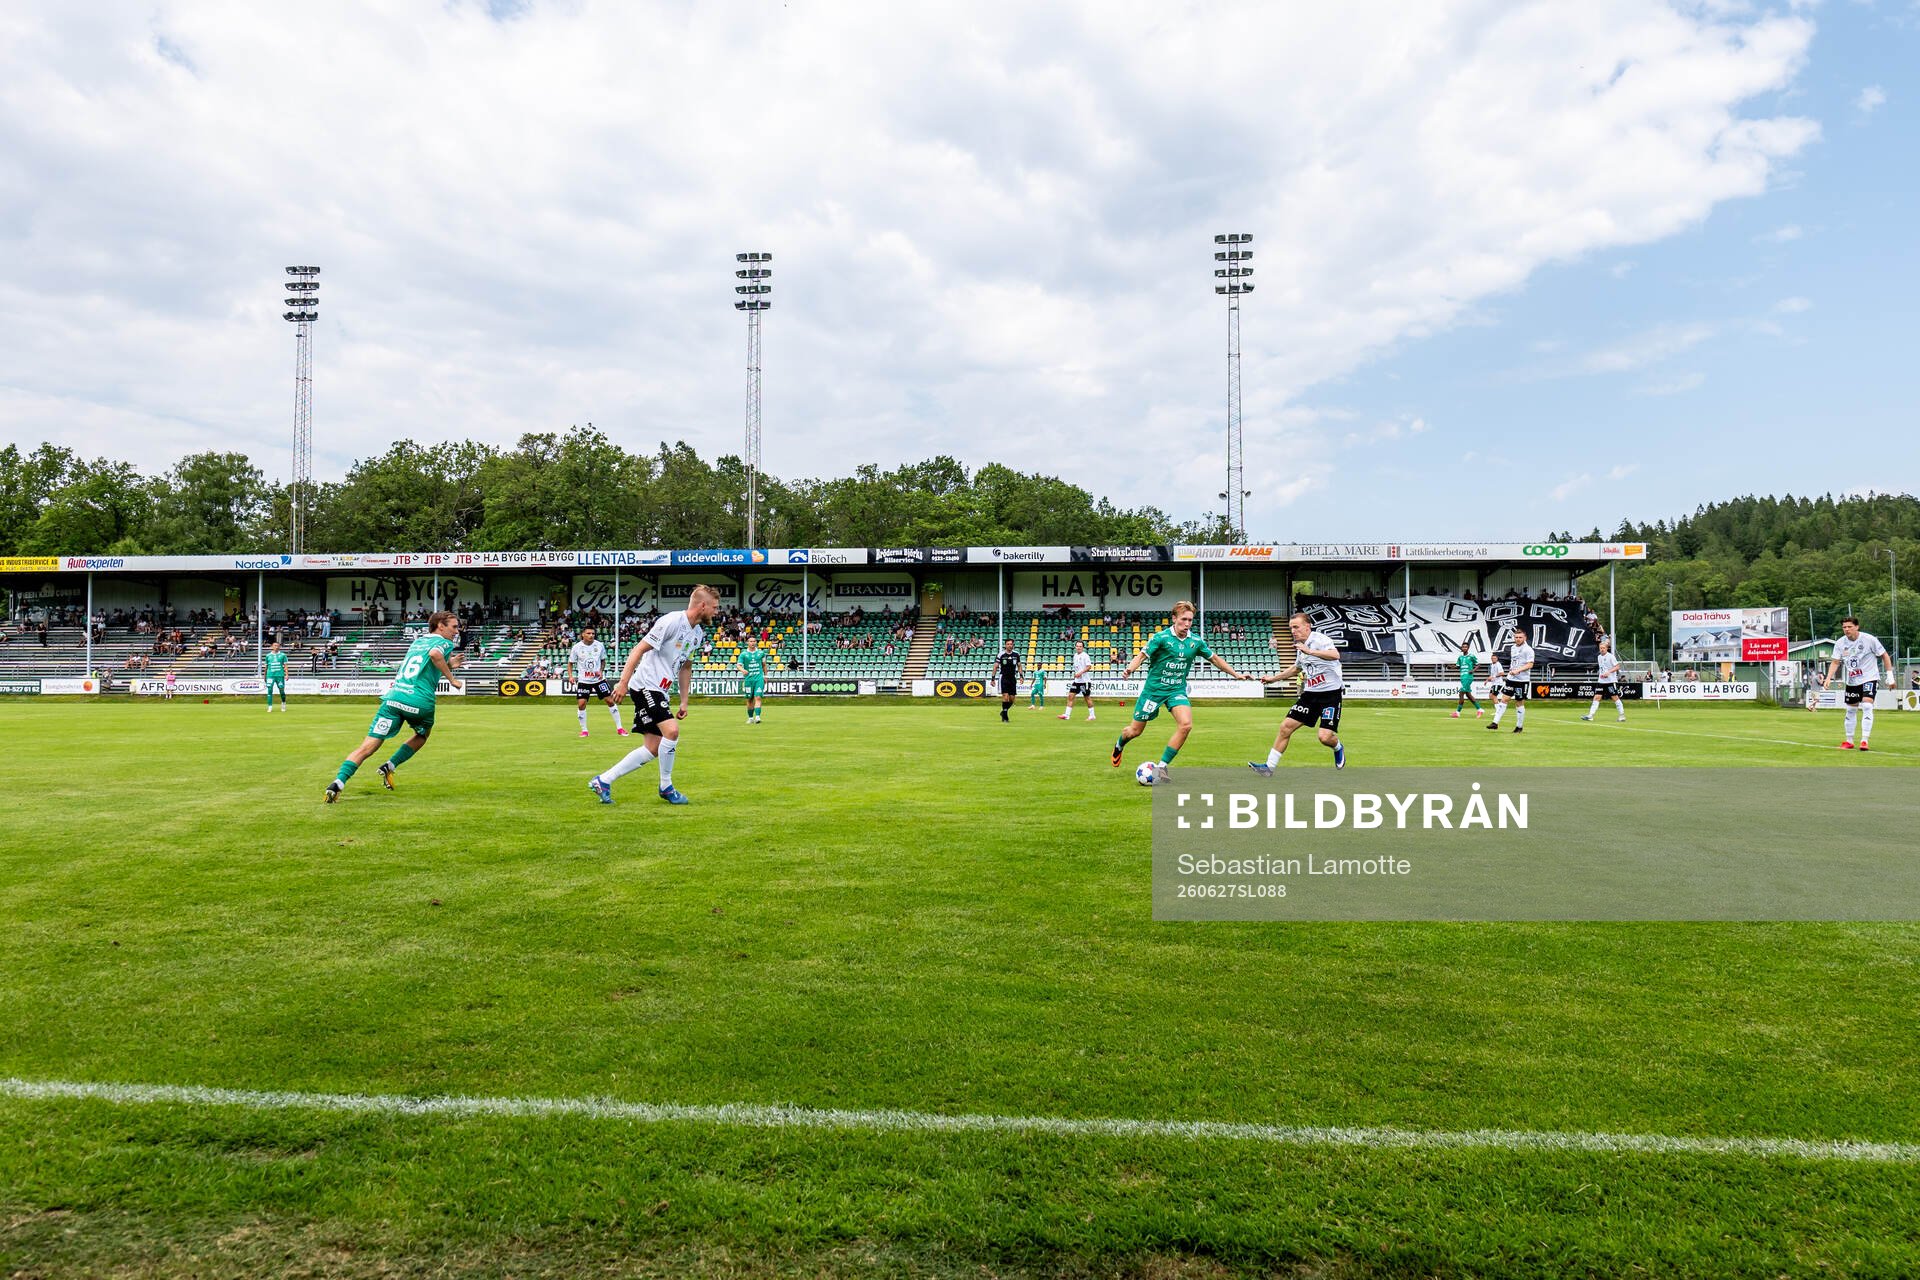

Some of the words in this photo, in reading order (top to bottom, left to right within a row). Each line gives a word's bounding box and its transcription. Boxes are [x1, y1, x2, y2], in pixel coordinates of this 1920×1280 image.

[1003, 551, 1045, 561] bakertilly
[1091, 547, 1151, 557] StorköksCenter
[1301, 546, 1341, 556] BELLA
[1344, 546, 1380, 555] MARE
[1405, 548, 1474, 558] Lättklinkerbetong
[1522, 545, 1569, 558] coop
[393, 556, 411, 565] JTB
[424, 555, 442, 564] JTB
[454, 554, 472, 564] JTB
[484, 554, 499, 562] H.A
[501, 553, 527, 562] BYGG
[531, 553, 546, 561] H.A
[549, 552, 574, 561] BYGG
[578, 552, 636, 565] LLENTAB
[678, 552, 744, 563] uddevalla.se
[811, 554, 847, 564] BioTech
[68, 558, 124, 570] Autoexperten
[235, 560, 280, 569] Nordea
[395, 580, 459, 601] BYGG
[839, 585, 906, 596] BRANDI
[1042, 574, 1085, 597] H.A
[1092, 574, 1163, 597] BYGG
[576, 578, 649, 610] Ford
[748, 577, 822, 609] Ford
[1302, 600, 1431, 628] ÖSK
[1442, 600, 1568, 624] GÖR
[1682, 613, 1703, 622] Dala
[1704, 612, 1731, 621] Trähus
[1318, 622, 1424, 654] ETT
[1430, 618, 1586, 659] MÅL!
[321, 682, 340, 691] Skylt
[1650, 685, 1667, 693] H.A
[1669, 685, 1696, 693] BYGG
[1703, 685, 1720, 693] H.A
[1722, 684, 1749, 693] BYGG
